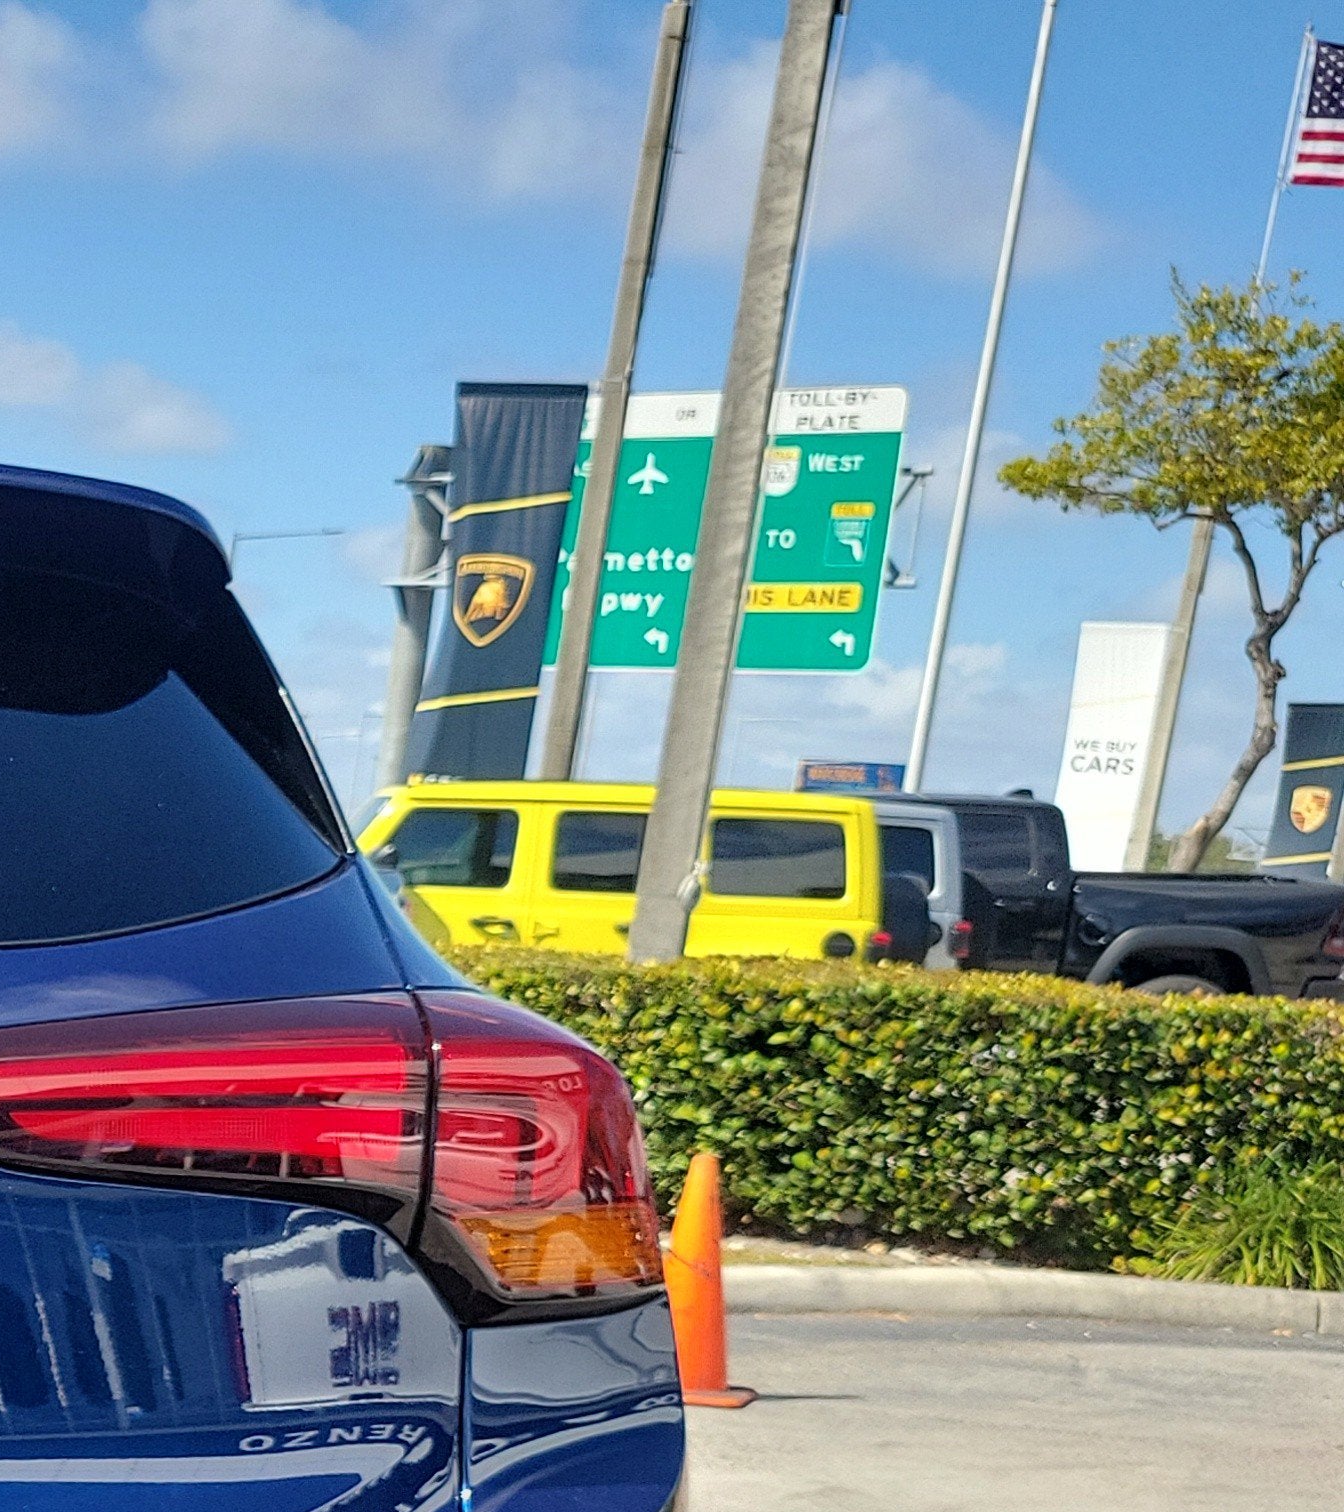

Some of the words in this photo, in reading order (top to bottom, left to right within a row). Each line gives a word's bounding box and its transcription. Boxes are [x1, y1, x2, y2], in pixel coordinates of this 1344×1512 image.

[795, 414, 861, 430] PLATE
[808, 452, 865, 472] WEST
[765, 529, 797, 549] TO
[787, 587, 852, 607] LANE
[1073, 739, 1101, 752] WE
[1104, 740, 1138, 753] BUY
[1070, 755, 1135, 776] CARS
